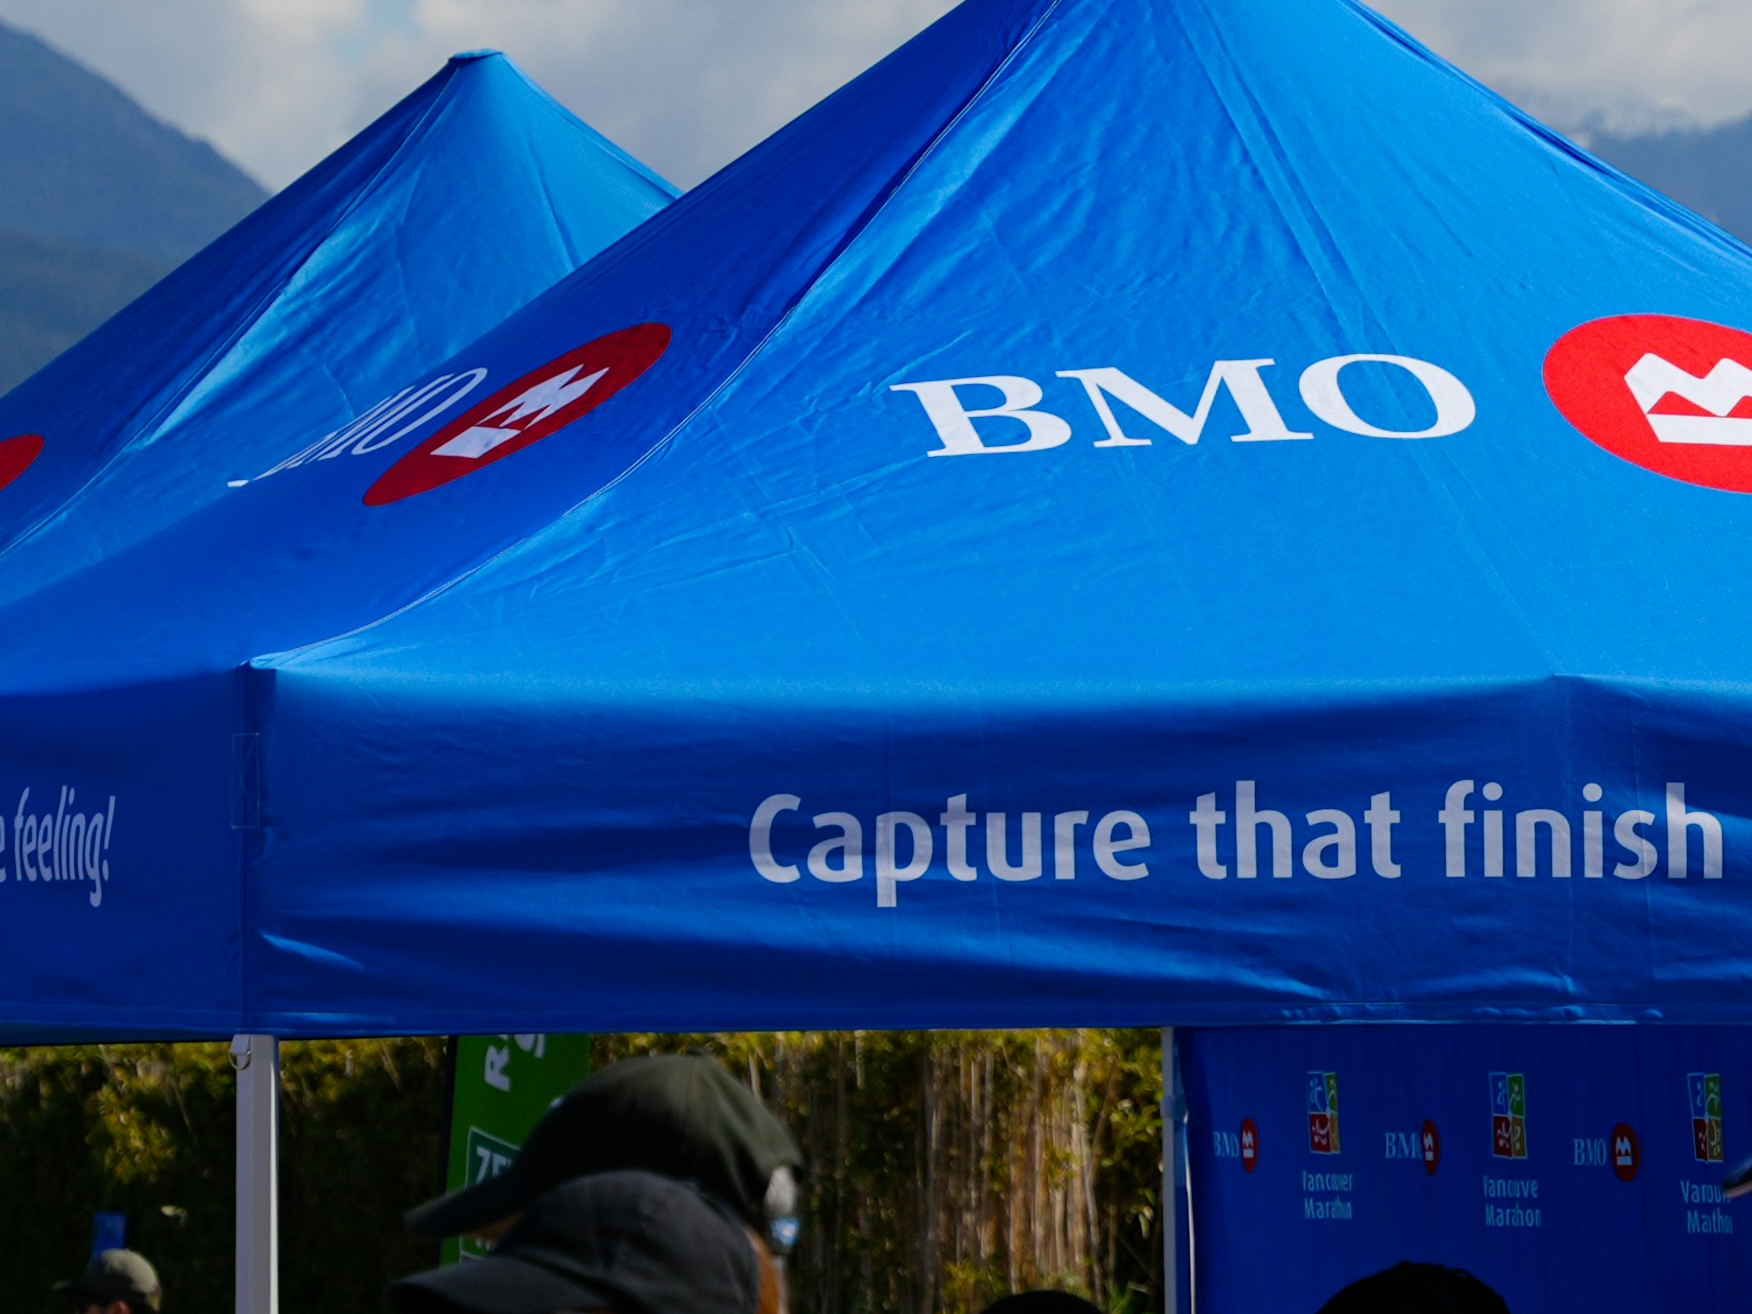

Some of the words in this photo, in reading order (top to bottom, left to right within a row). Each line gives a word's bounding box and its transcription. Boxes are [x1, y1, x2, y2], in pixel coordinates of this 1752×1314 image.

[890, 353, 1477, 458] BMO
[14, 784, 116, 908] feeling!
[749, 792, 1152, 909] Capture
[1190, 780, 1402, 881] that
[1439, 779, 1724, 882] finish
